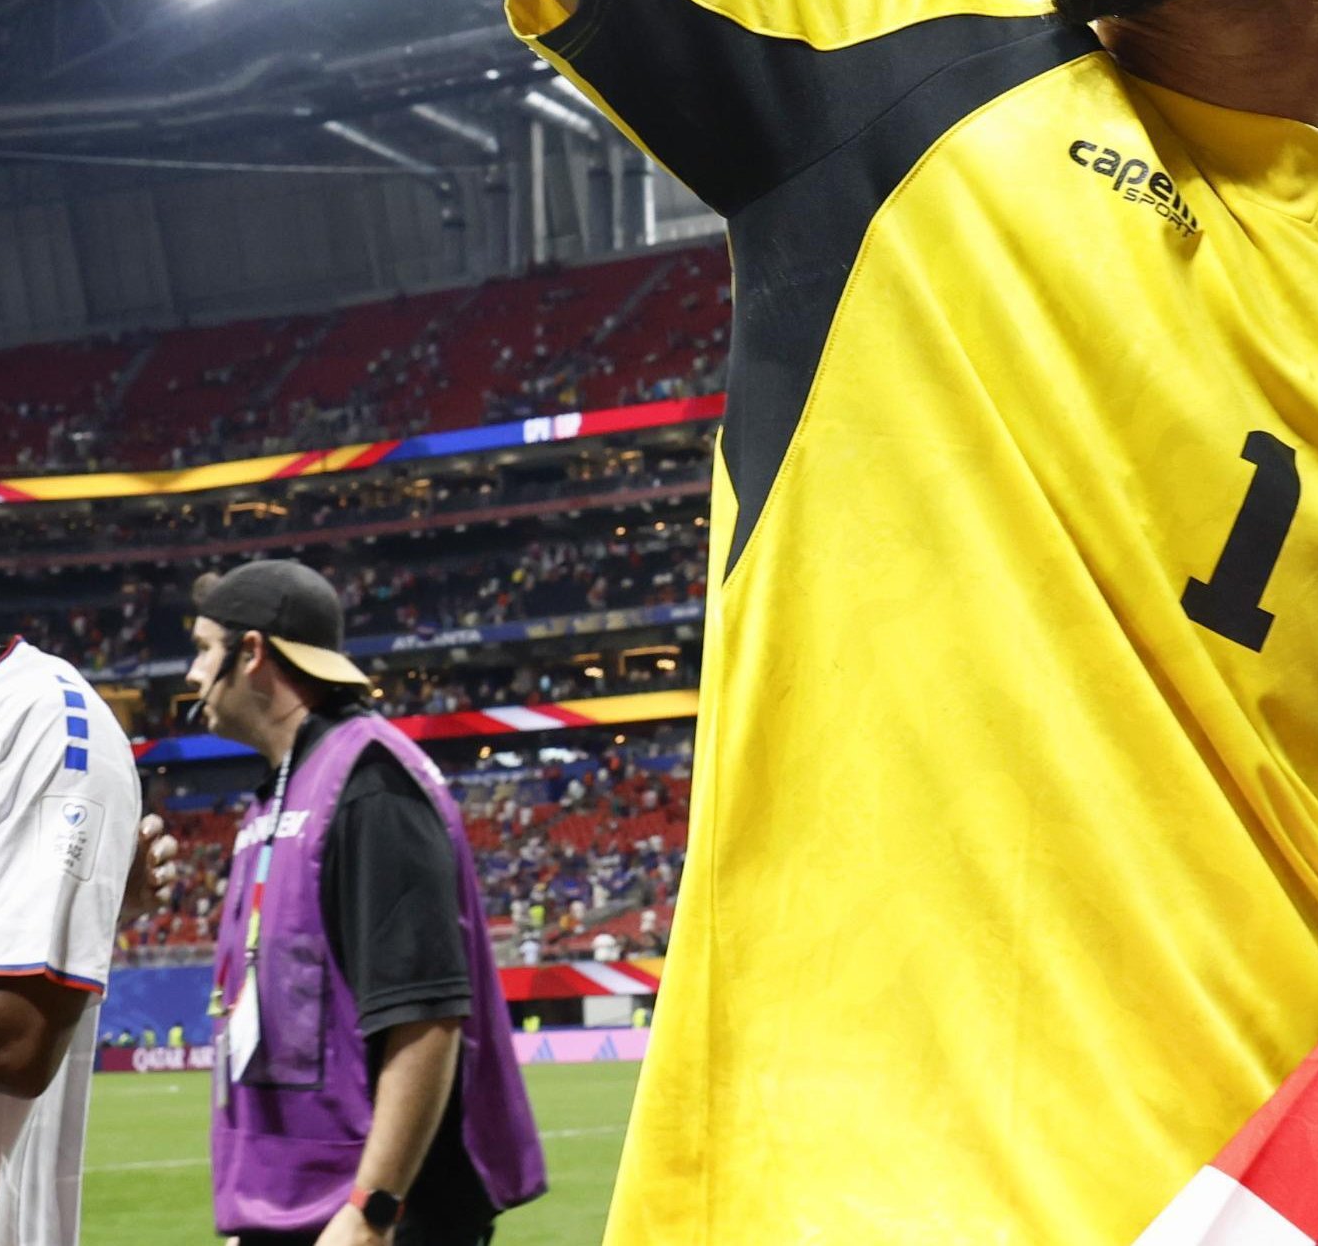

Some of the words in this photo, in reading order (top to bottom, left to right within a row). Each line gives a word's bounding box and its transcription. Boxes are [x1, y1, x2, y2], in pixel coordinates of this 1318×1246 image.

[1068, 139, 1199, 230] capelli
[1122, 187, 1196, 239] SPORT
[1179, 429, 1302, 654] 1
